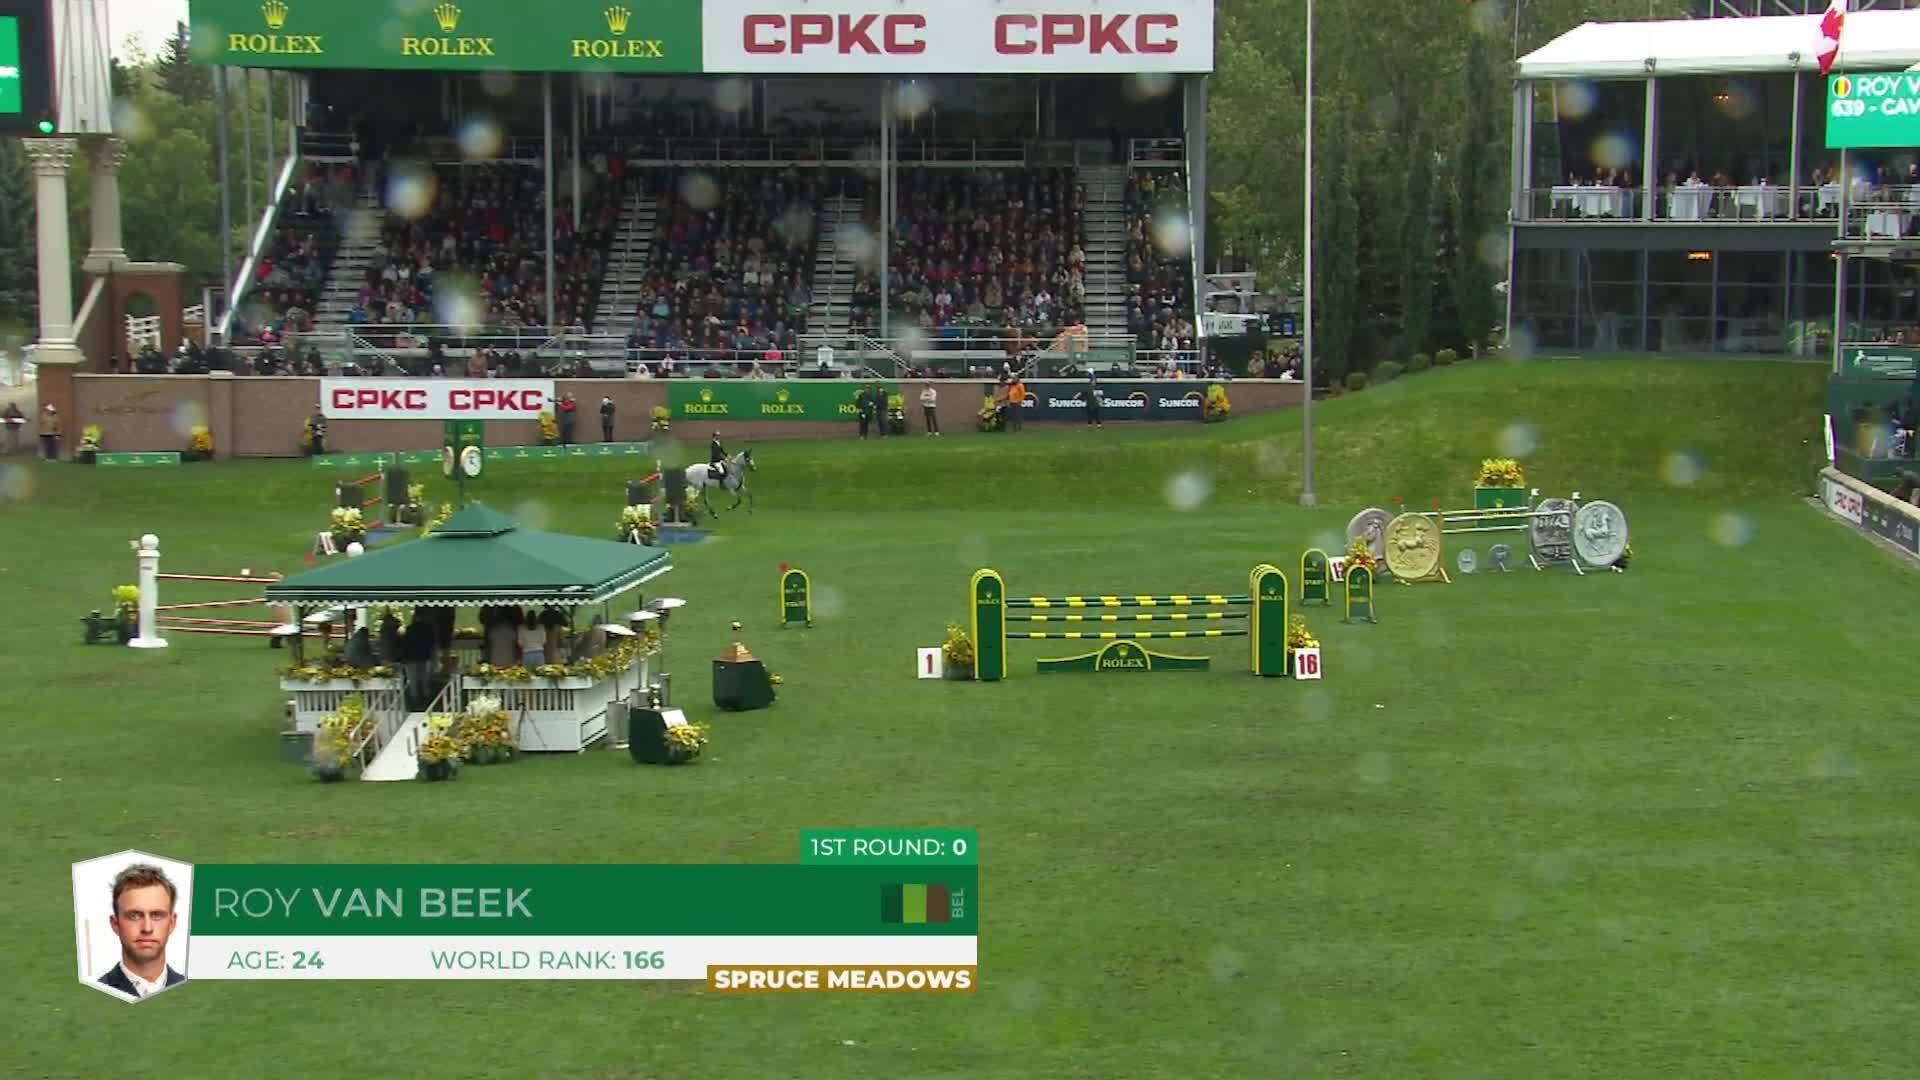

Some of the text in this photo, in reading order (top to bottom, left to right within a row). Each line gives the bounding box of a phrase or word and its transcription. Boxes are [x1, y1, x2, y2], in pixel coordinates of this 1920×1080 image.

[228, 34, 323, 53] ROLEX
[743, 14, 926, 54] CPKC
[995, 14, 1178, 54] CPKC
[402, 37, 495, 56] ROLEX
[571, 39, 664, 58] ROLEX
[1857, 76, 1903, 96] ROY
[332, 389, 427, 409] CPKC
[449, 390, 542, 410] CPKC
[684, 403, 728, 414] ROLEX
[761, 403, 804, 414] ROLEX
[925, 654, 933, 674] 1
[1103, 658, 1144, 668] ROLEX
[1298, 653, 1318, 675] 16
